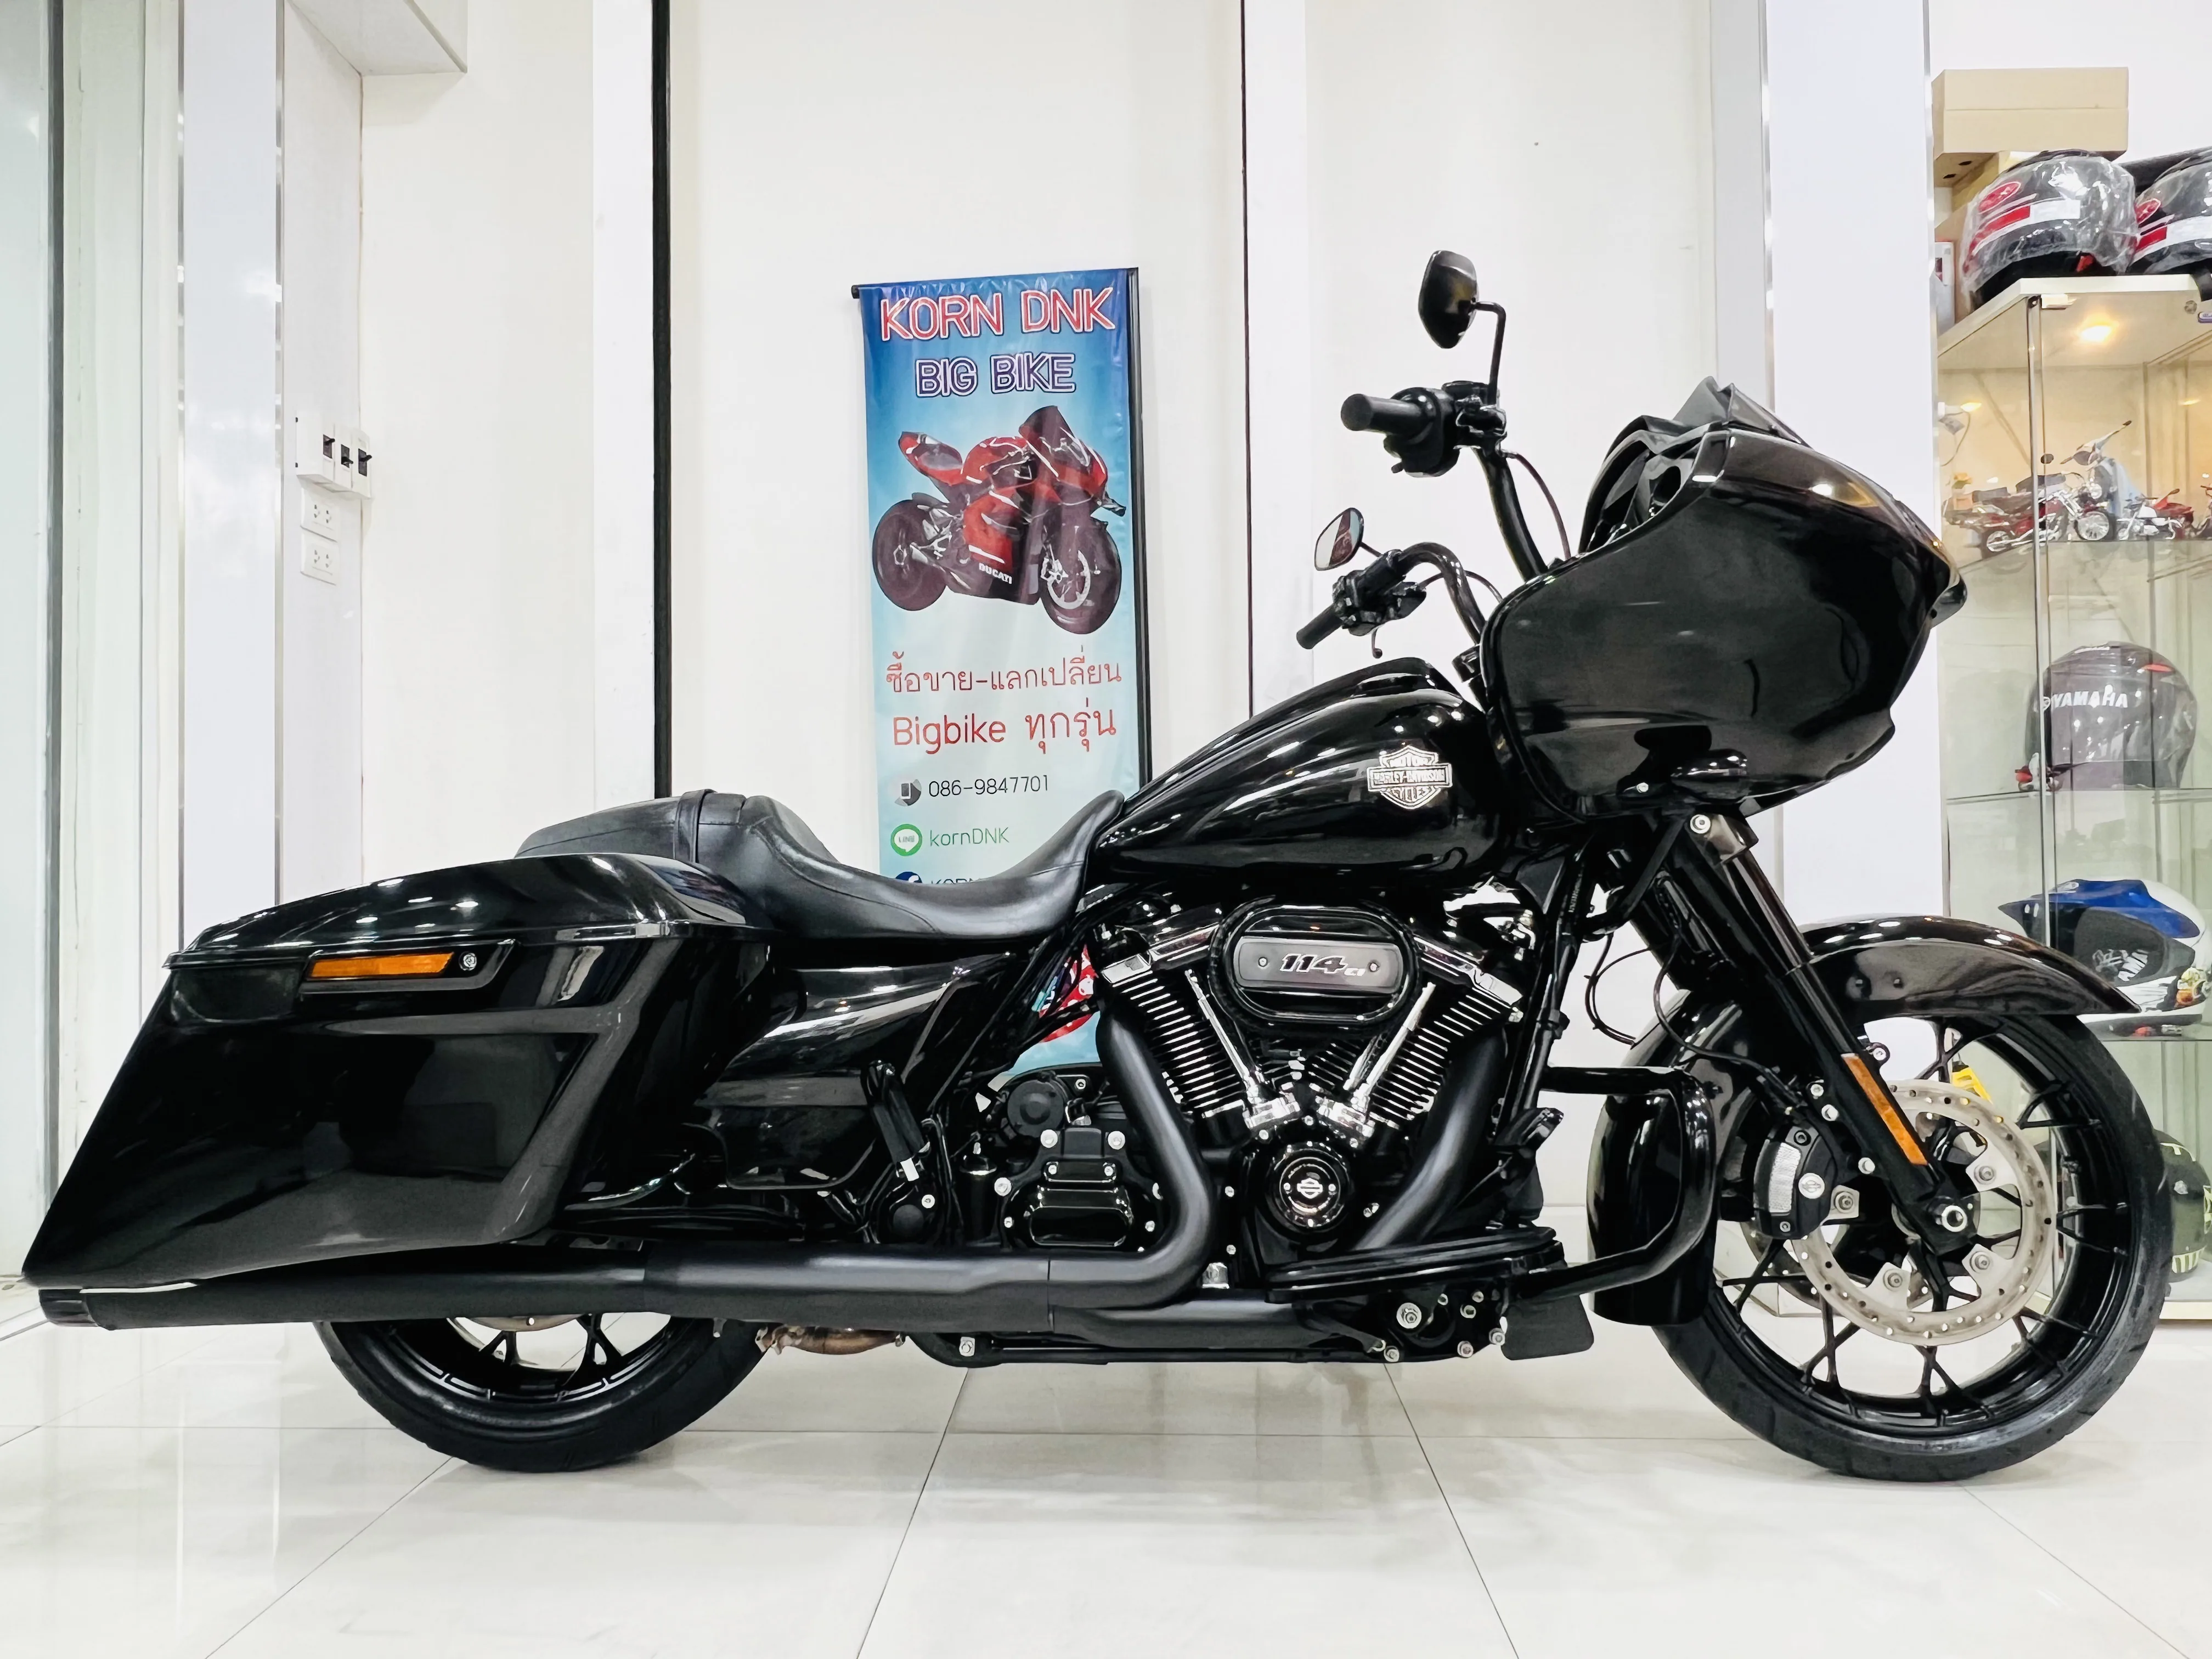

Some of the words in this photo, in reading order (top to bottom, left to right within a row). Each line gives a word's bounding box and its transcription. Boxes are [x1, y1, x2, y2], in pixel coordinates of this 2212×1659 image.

[881, 292, 1003, 341] KORN
[1021, 287, 1115, 333] DNK
[916, 357, 977, 397] BIG
[990, 352, 1075, 394] BIKE
[979, 562, 1012, 584] DUCATI
[885, 645, 1122, 692] ซื้อขาย-แลกเปลี่ยน
[2052, 690, 2128, 708] YAMAHA
[893, 713, 1006, 754] Bigbike
[1025, 697, 1116, 754] ทุกรุ่น
[928, 775, 1048, 797] 086-9847701
[930, 827, 1009, 847] kornDNK
[1279, 953, 1348, 974] 114
